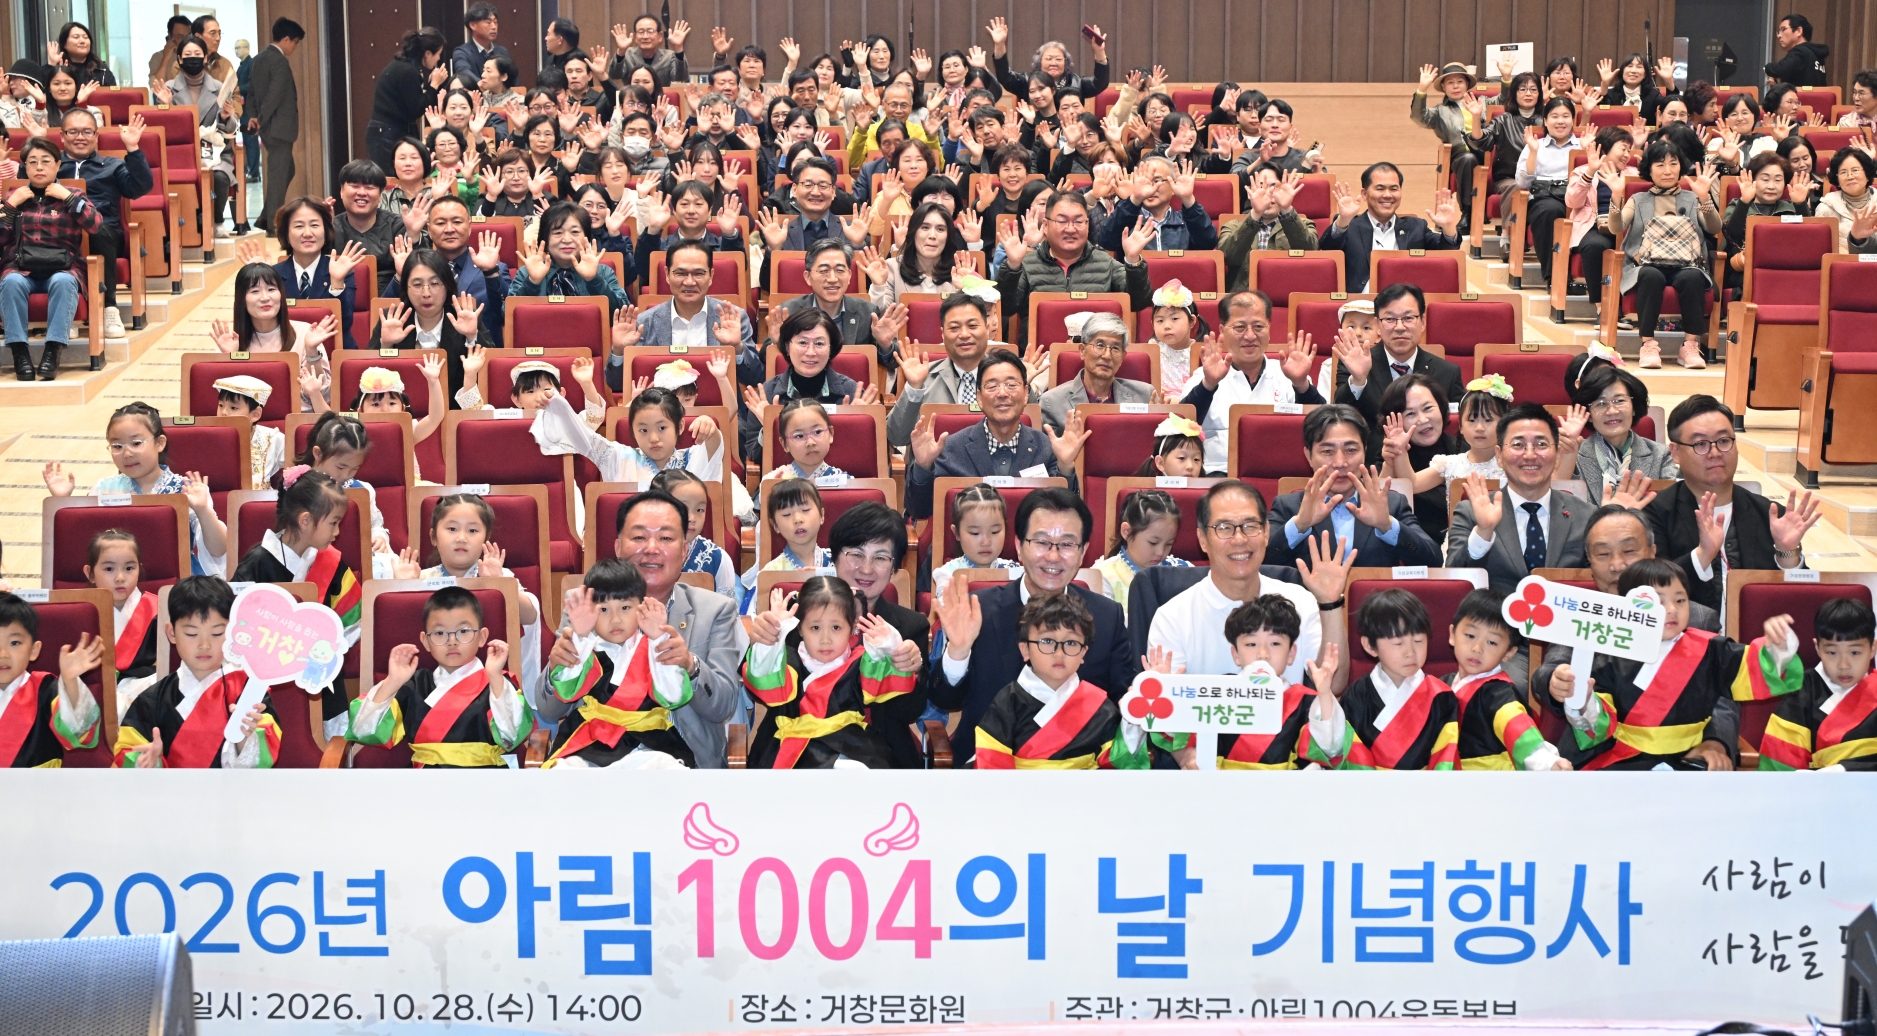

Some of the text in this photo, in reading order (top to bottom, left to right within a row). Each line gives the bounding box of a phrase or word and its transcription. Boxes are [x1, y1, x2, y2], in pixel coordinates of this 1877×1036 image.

[255, 607, 279, 623] 사람이
[280, 618, 303, 633] 사람을
[1554, 596, 1658, 628] 나눔으로 하나되는
[257, 625, 304, 667] 거창
[1571, 619, 1634, 650] 거창군
[1172, 686, 1276, 700] 나눔으로 하나되는
[1191, 704, 1255, 726] 거창군
[1702, 857, 1826, 900] 사람이
[50, 850, 1643, 980] 2026년 아림1004의 날 기념행사
[1702, 925, 1824, 981] 사람을
[547, 994, 642, 1022] 14:00
[821, 994, 965, 1024] 거창문화원
